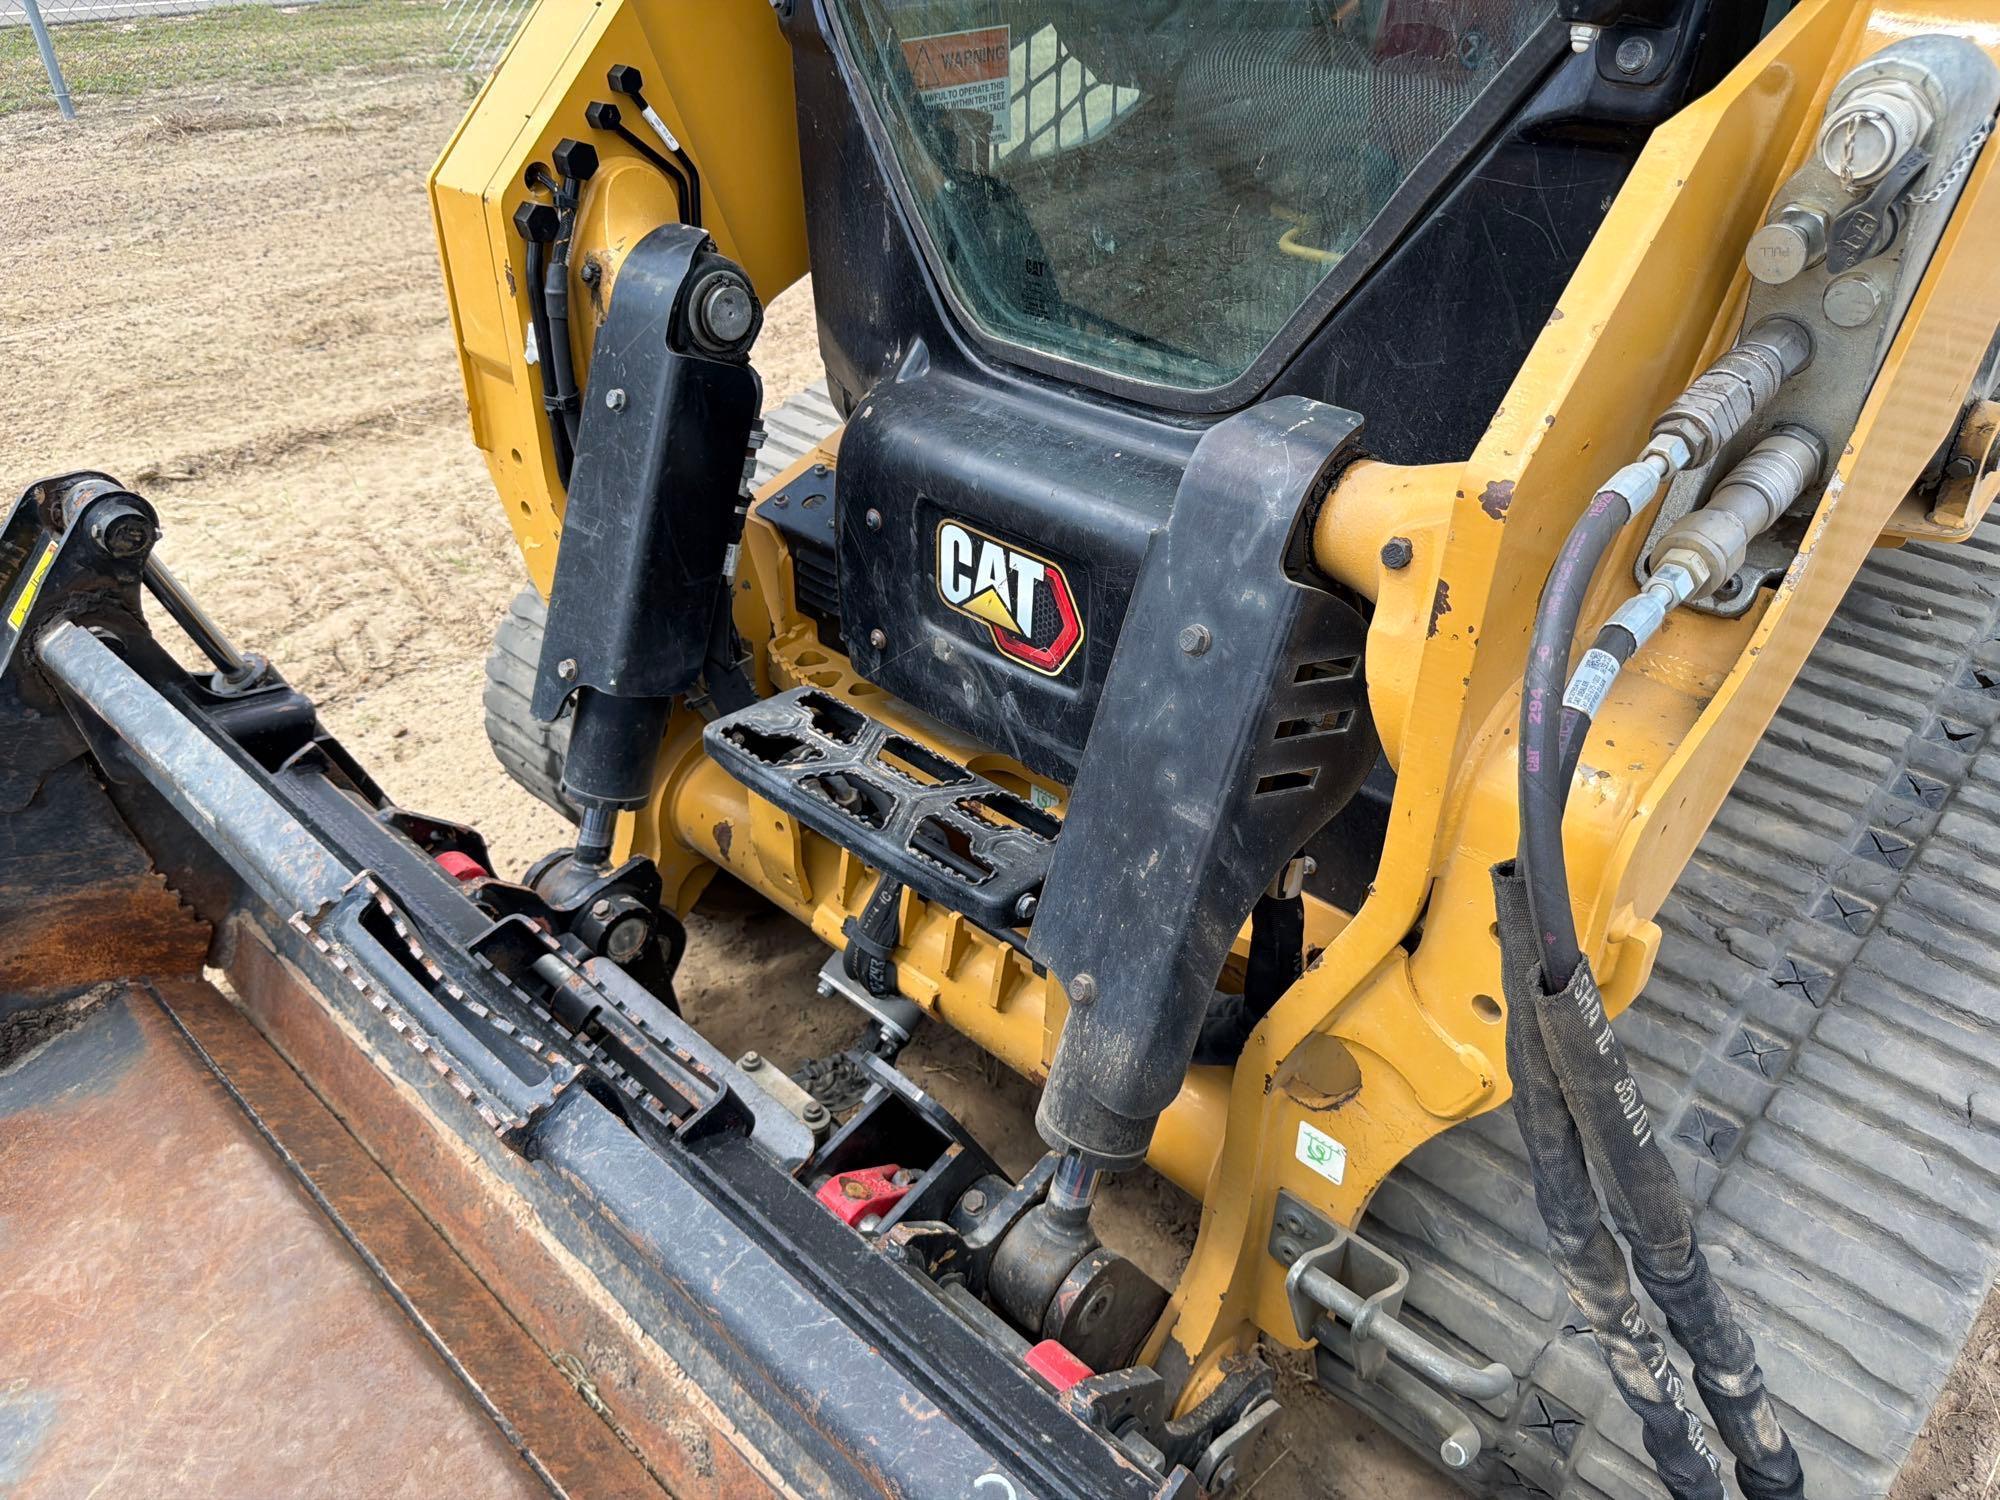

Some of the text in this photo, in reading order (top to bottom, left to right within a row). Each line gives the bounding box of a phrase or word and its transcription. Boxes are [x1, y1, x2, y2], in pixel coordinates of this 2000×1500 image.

[941, 44, 1006, 70] WARNING
[948, 89, 958, 99] TO
[958, 84, 989, 97] OPERATE
[990, 80, 1005, 91] THIS
[950, 97, 974, 108] WITHIN
[974, 95, 988, 105] TEN
[988, 91, 1005, 102] FEET
[1760, 246, 1792, 257] PULL
[1025, 258, 1045, 277] CAT
[940, 524, 1045, 639] CAT
[1528, 687, 1544, 725] 294
[1526, 744, 1541, 773] CAT
